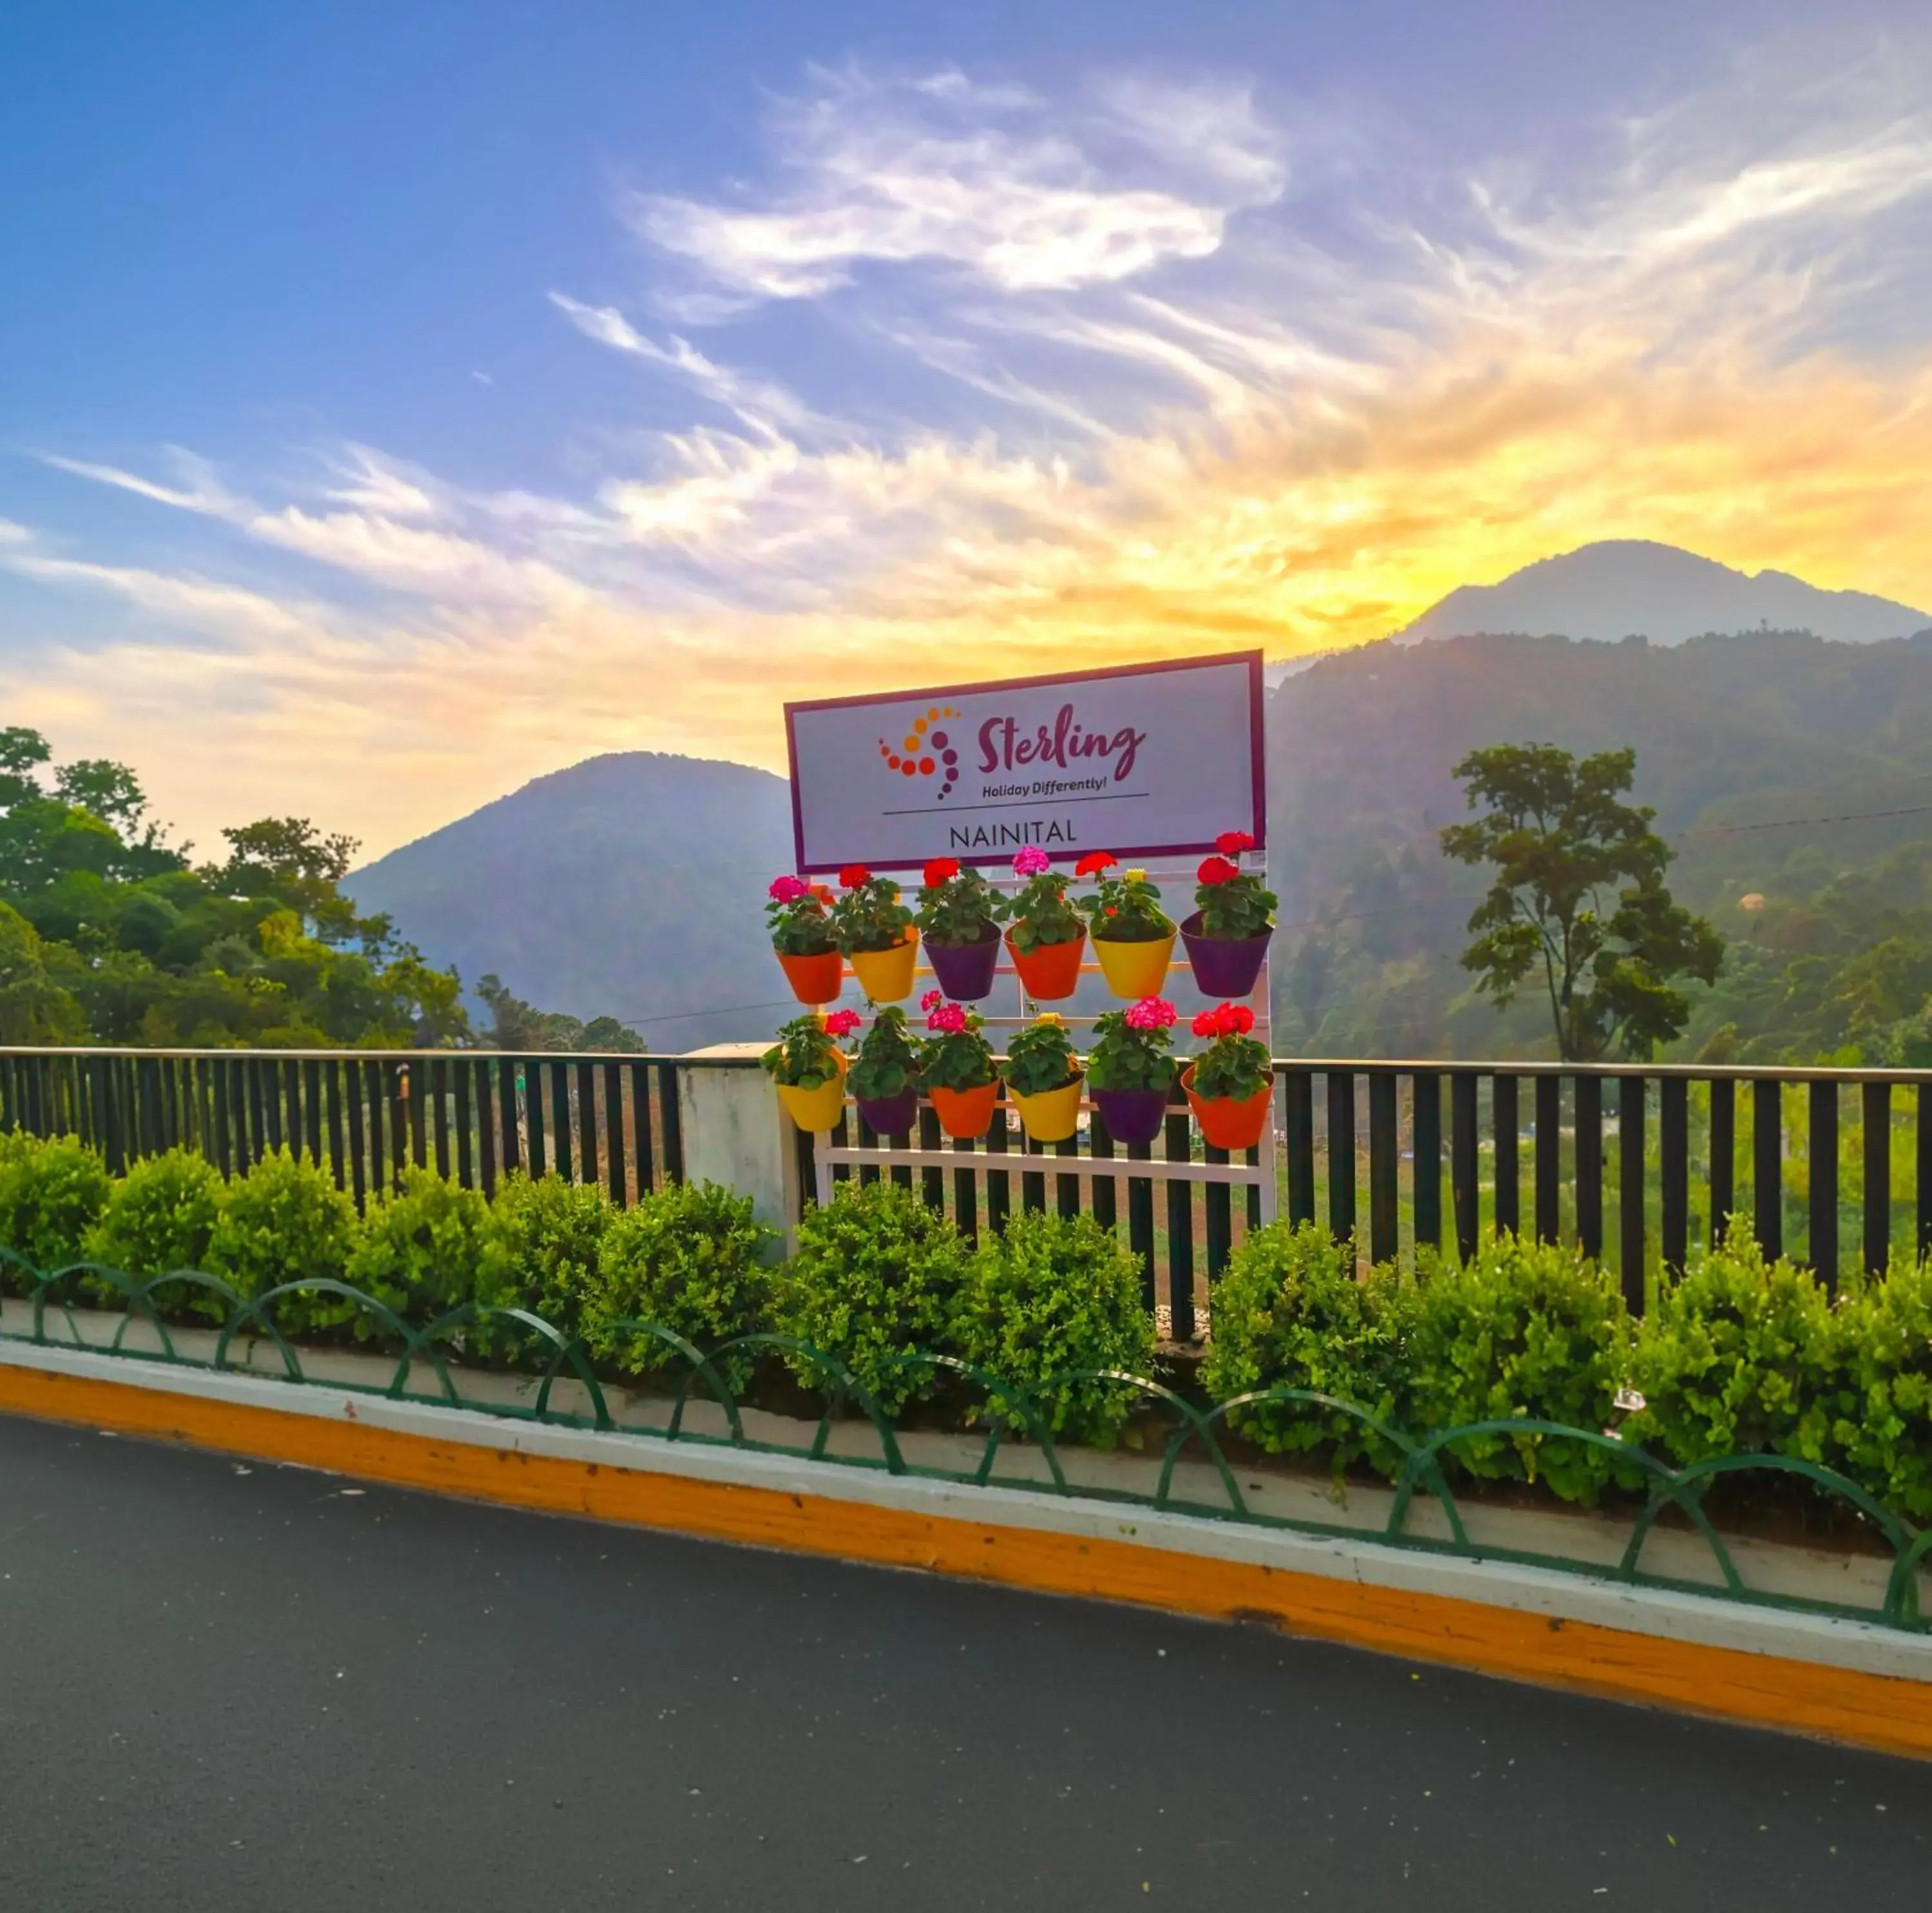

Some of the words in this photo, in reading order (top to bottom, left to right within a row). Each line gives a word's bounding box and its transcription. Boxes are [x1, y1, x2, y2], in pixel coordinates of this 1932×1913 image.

[978, 703, 1146, 782] Sterling
[983, 784, 1030, 798] Holiday
[1032, 777, 1107, 795] Differently!
[950, 819, 1077, 848] NAINITAL
